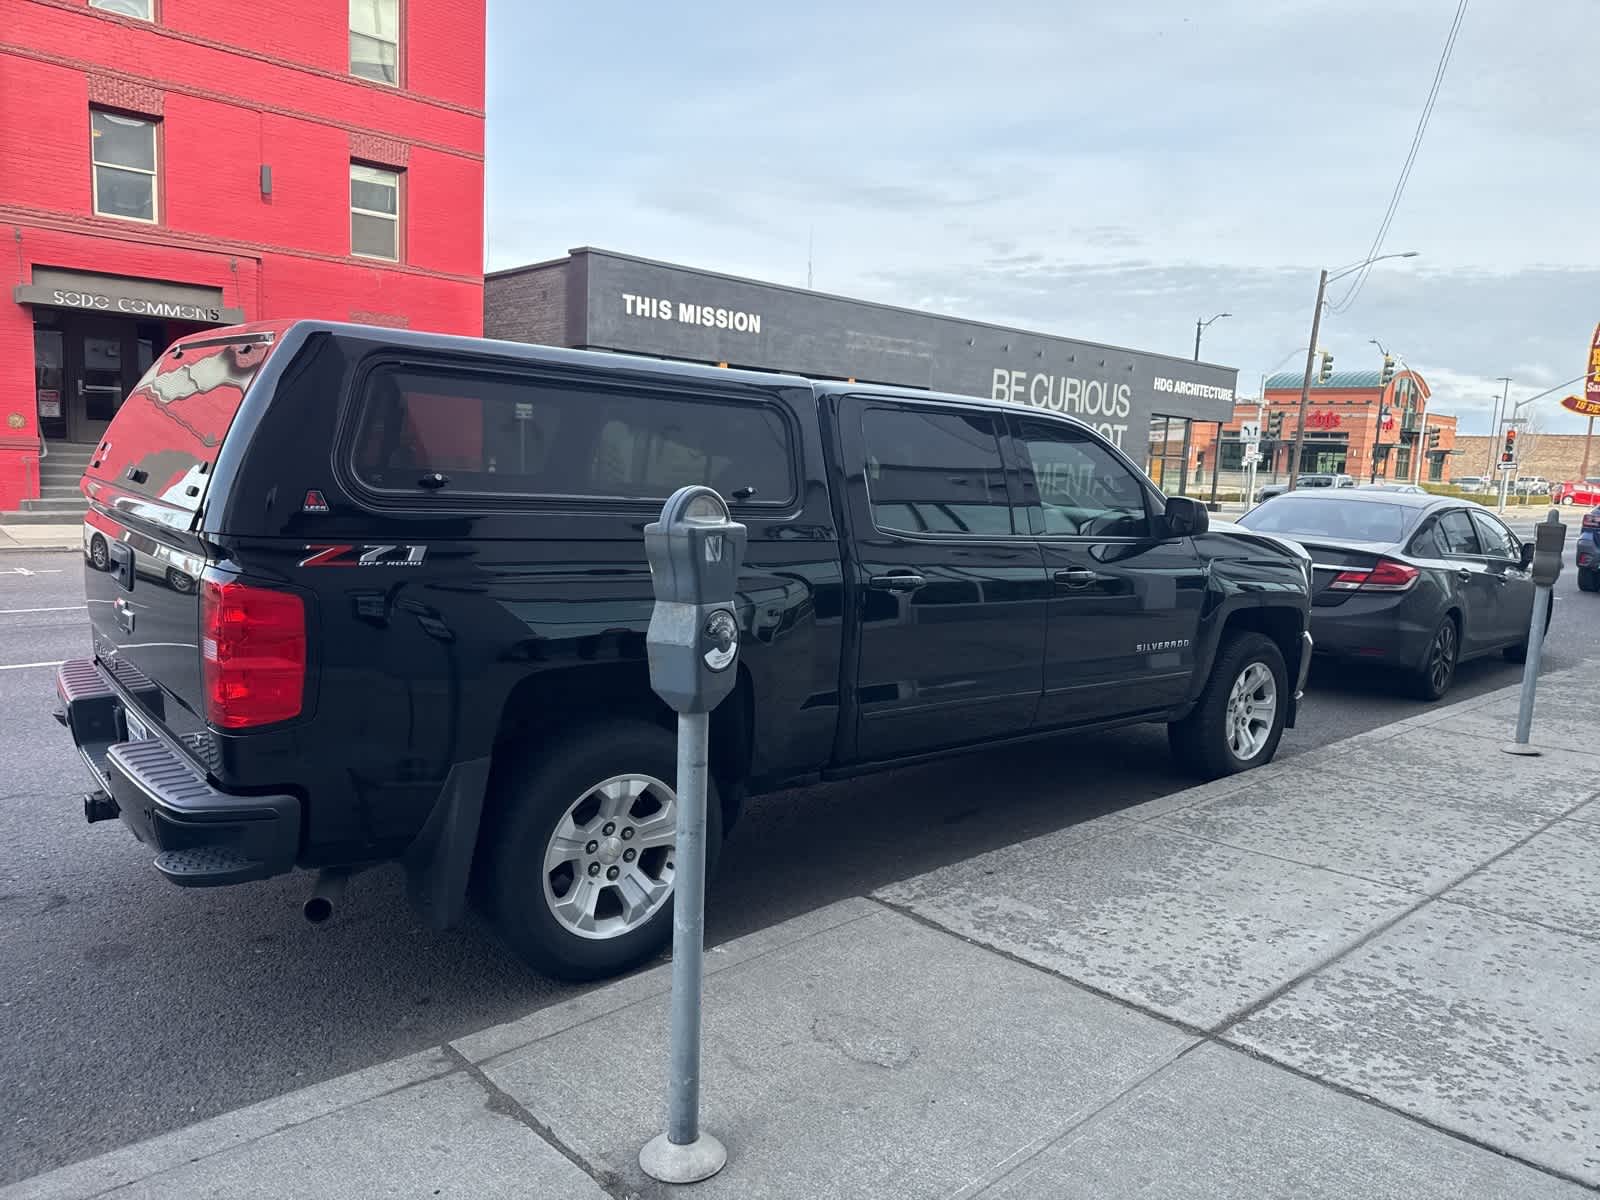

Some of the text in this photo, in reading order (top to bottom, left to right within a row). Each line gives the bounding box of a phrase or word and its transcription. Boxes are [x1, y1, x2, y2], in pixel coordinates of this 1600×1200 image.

[54, 291, 220, 321] SODO COMMONS
[622, 293, 761, 334] THIS MISSION
[991, 368, 1131, 418] BE CURIOUS
[1153, 376, 1233, 401] HDG ARCHITECTURE
[297, 544, 428, 567] Z71
[1136, 639, 1190, 653] SILVERADO
